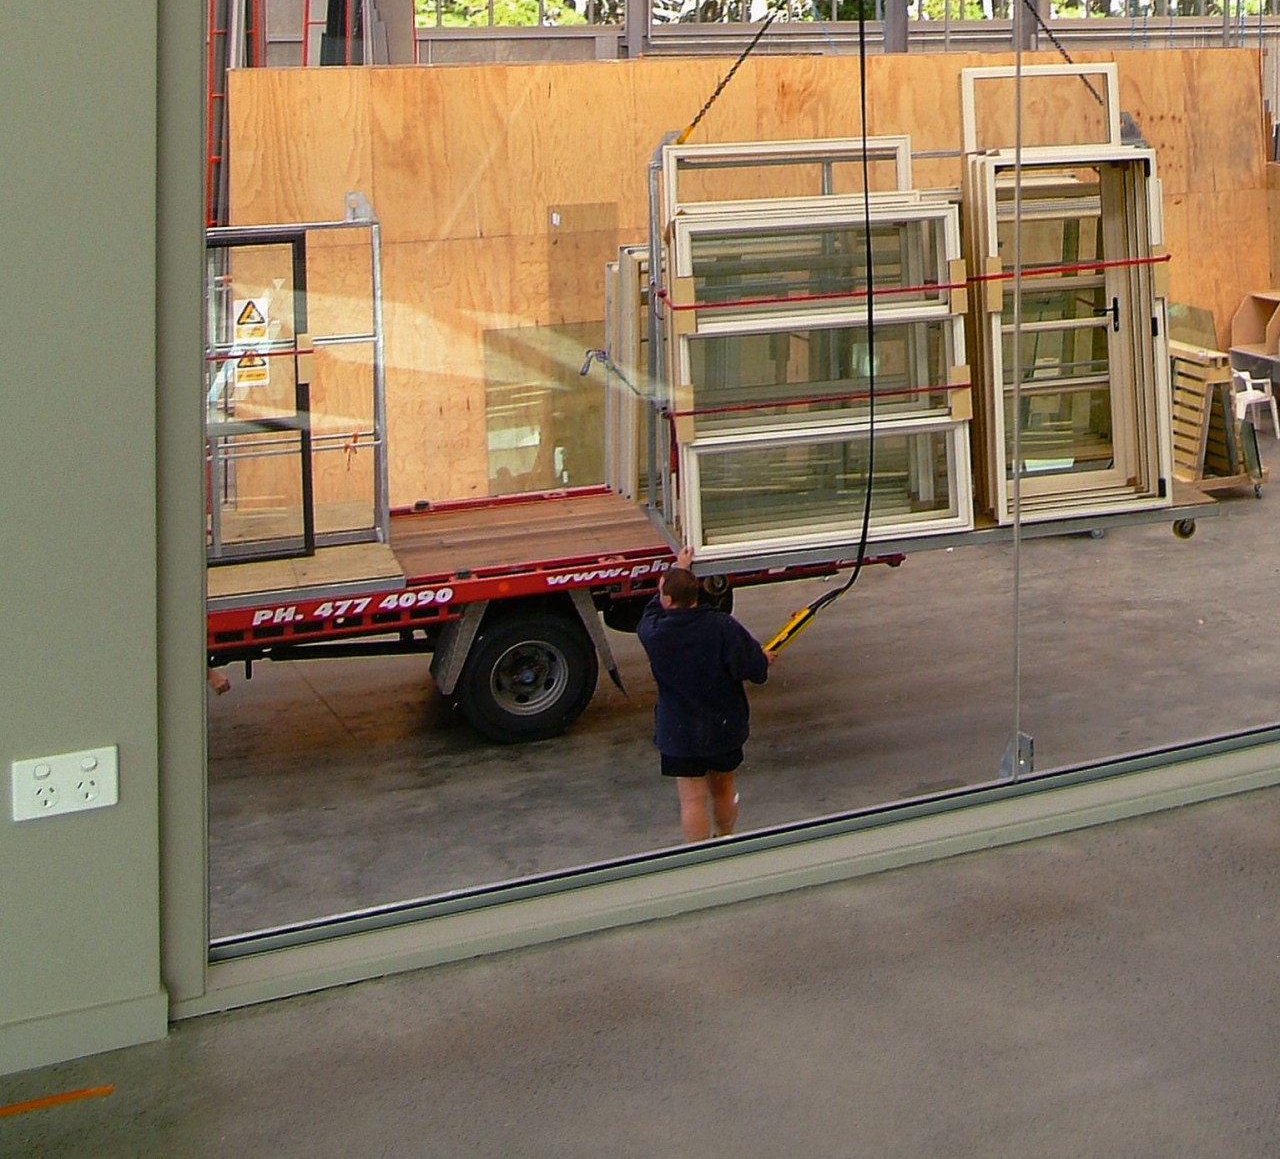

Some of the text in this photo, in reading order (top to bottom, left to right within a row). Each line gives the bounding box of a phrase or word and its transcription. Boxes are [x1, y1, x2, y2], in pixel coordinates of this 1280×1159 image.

[252, 587, 454, 626] PH. 477 4090
